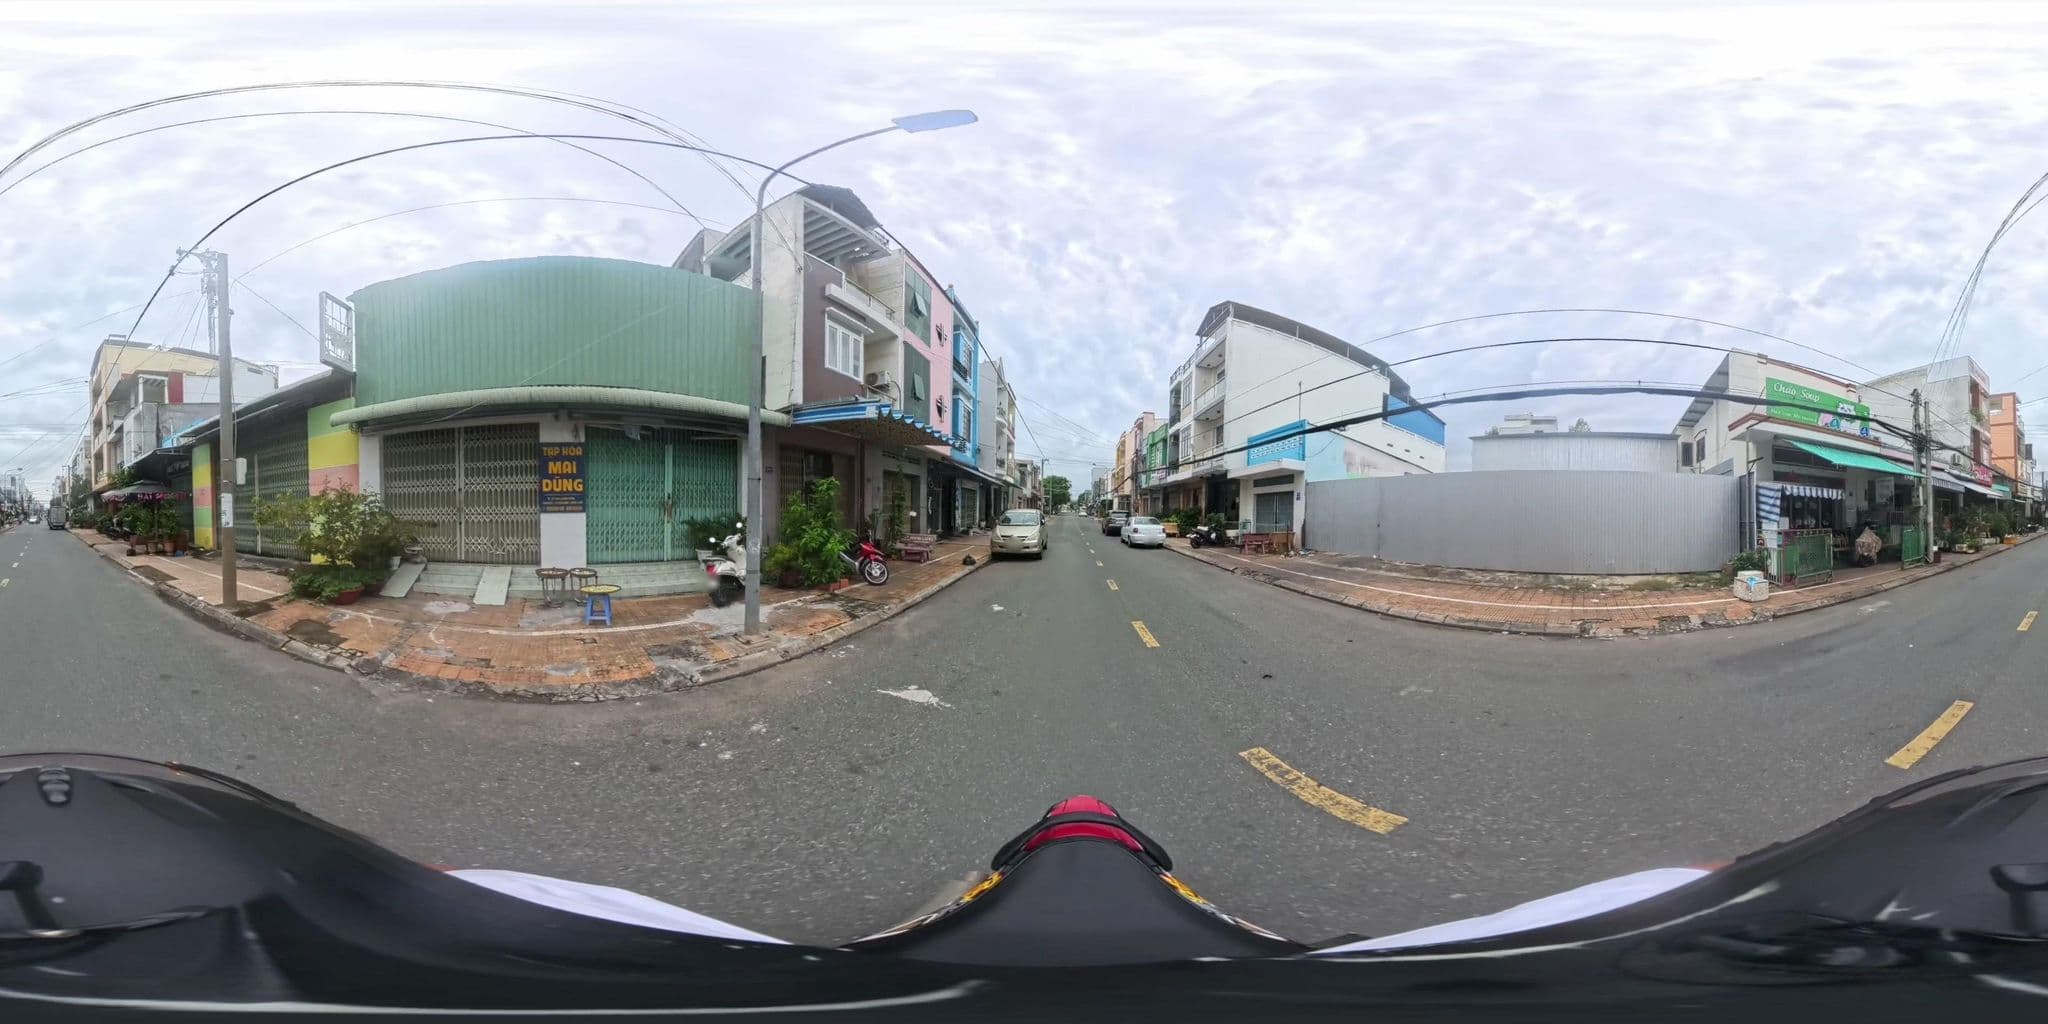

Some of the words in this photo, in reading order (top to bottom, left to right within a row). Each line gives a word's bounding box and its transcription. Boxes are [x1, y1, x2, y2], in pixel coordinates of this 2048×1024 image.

[1800, 389, 1820, 402] Soup
[548, 461, 577, 474] MAI
[542, 477, 584, 492] DŨNG
